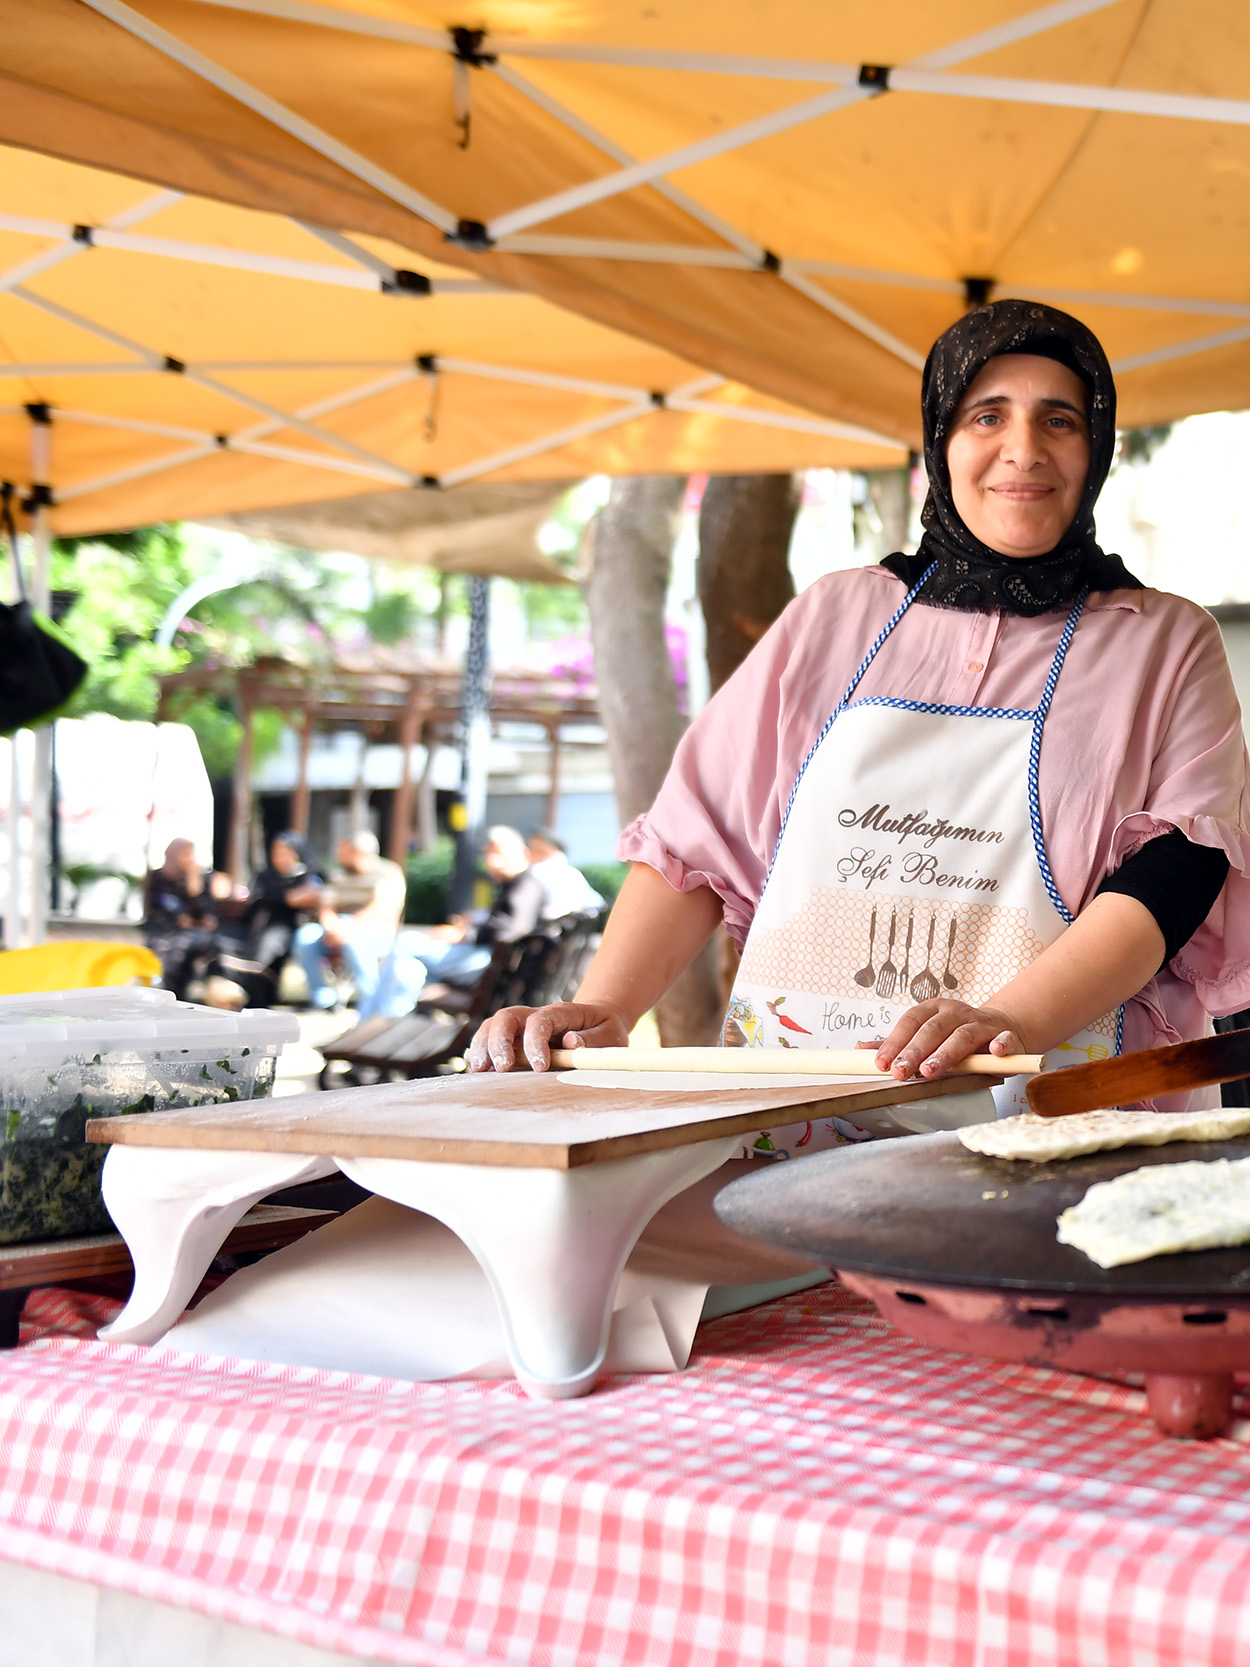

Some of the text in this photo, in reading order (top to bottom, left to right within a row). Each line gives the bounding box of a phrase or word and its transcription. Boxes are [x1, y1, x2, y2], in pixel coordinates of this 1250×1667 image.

[838, 804, 1005, 849] Mutfağımın
[837, 847, 999, 892] Şefi Benim
[822, 1002, 891, 1032] Home is
